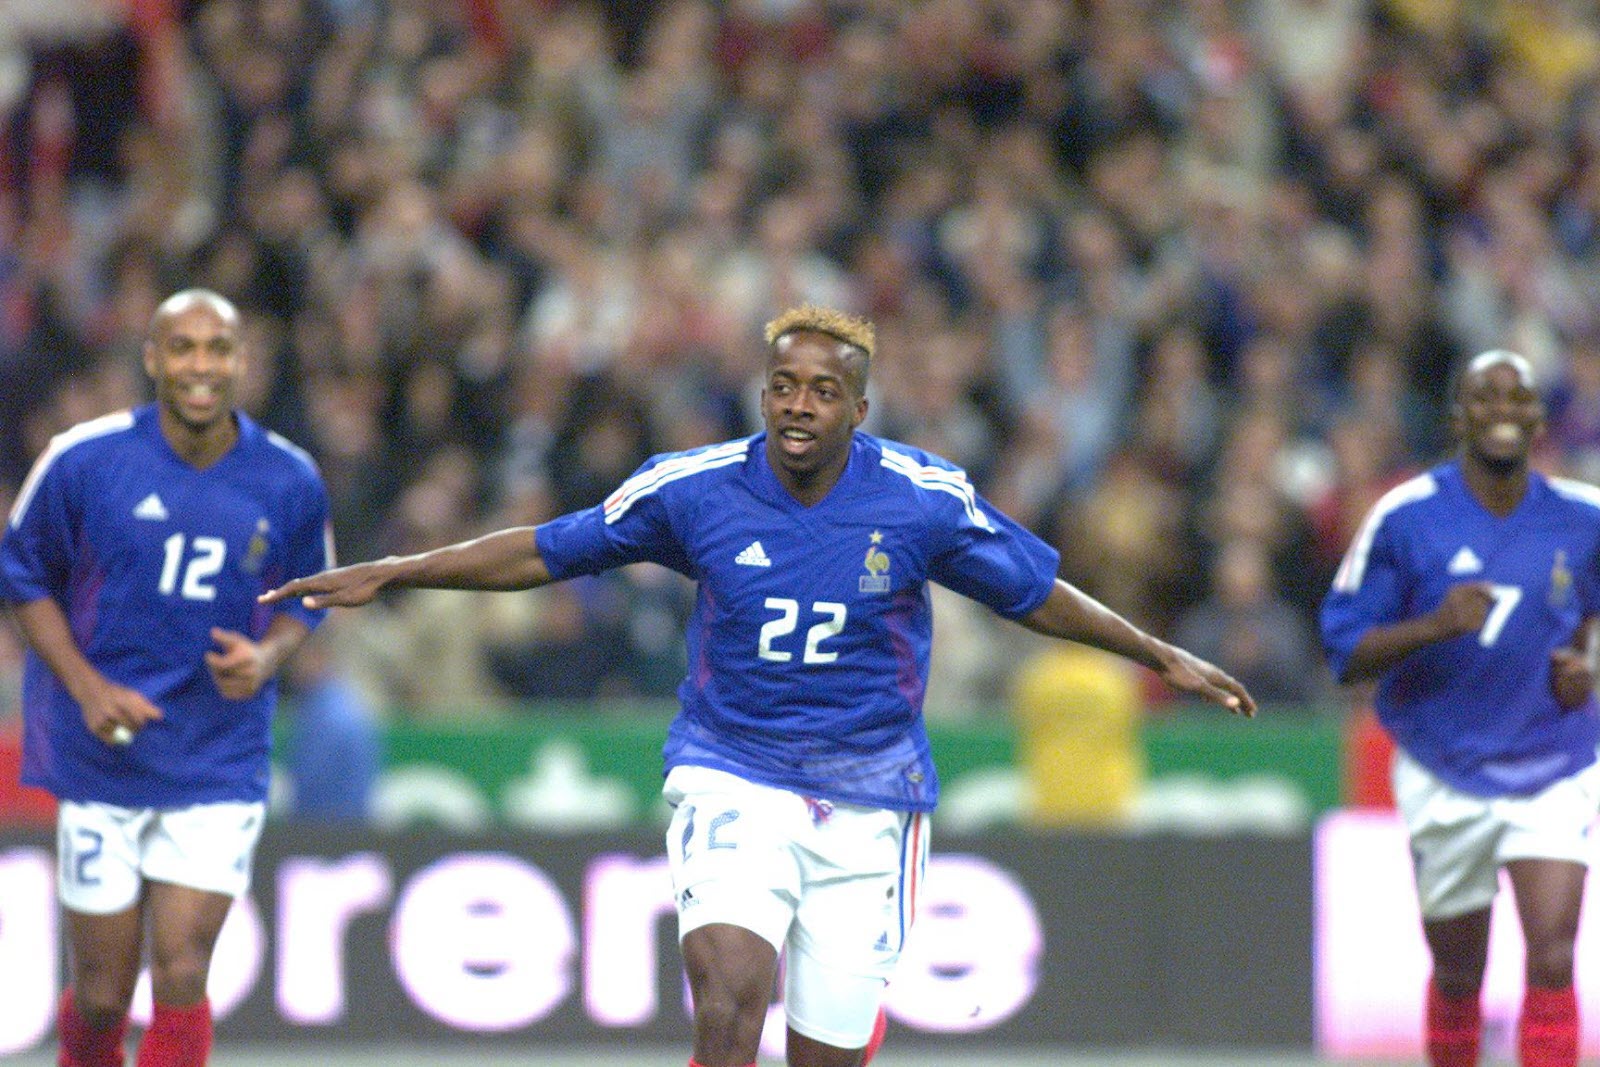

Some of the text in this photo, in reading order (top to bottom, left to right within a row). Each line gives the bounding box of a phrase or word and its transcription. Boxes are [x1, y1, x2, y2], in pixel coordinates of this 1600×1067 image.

[158, 533, 226, 600] 12
[758, 597, 847, 664] 22
[1480, 585, 1522, 647] 7
